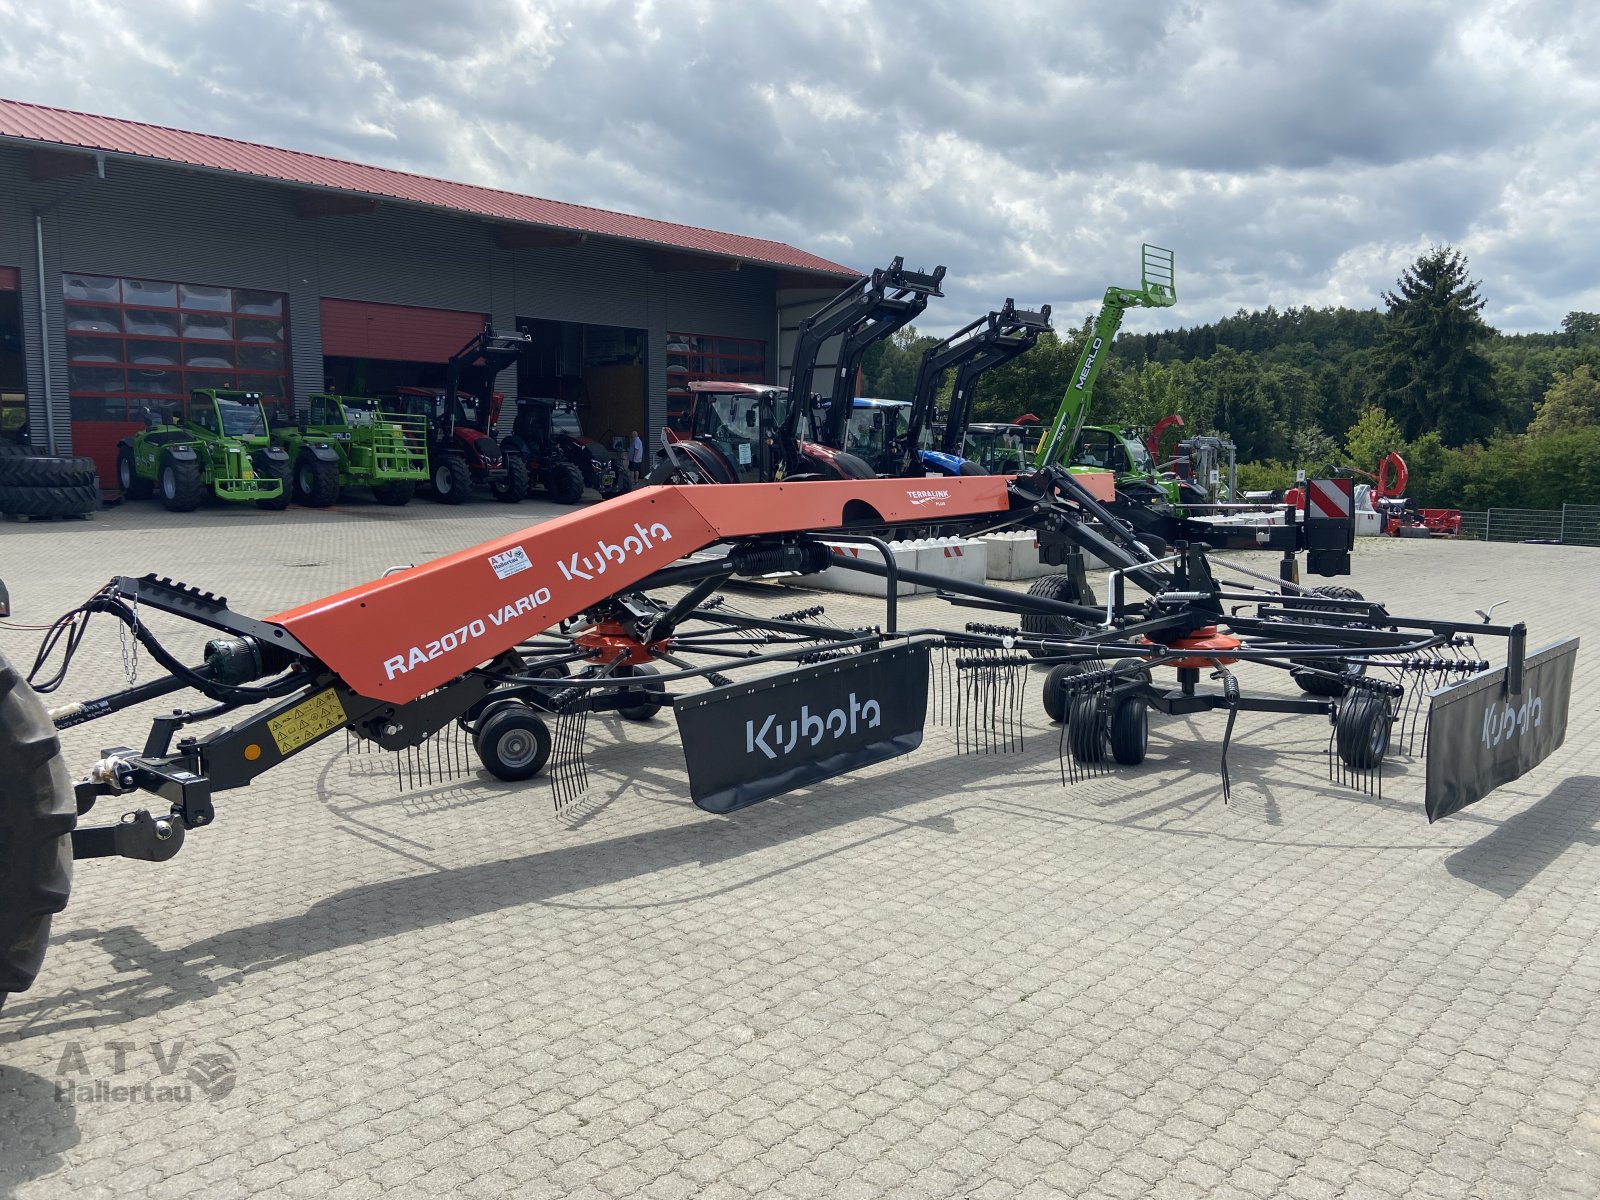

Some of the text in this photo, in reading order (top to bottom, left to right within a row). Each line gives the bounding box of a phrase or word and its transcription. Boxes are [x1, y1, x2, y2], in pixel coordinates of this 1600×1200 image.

[1076, 338, 1102, 389] MERLO
[907, 490, 948, 498] TERRALINK
[490, 551, 513, 565] ATV
[493, 558, 518, 569] Hallertau
[556, 522, 672, 581] Kubota
[383, 587, 551, 680] RA2070 VARIO
[746, 692, 881, 759] Kubota
[1482, 687, 1542, 749] Kubota
